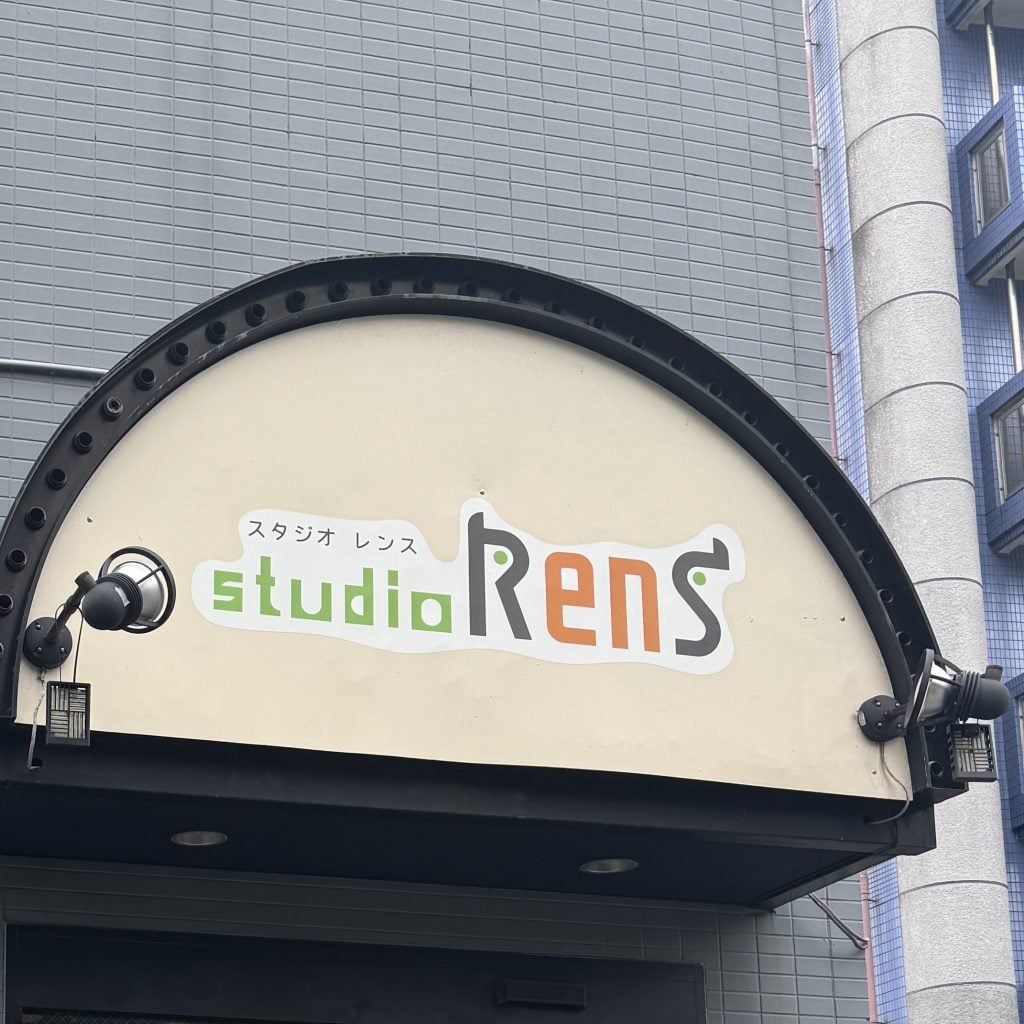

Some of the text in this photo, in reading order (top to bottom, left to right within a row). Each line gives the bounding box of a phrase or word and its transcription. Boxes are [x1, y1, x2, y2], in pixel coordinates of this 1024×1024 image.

[248, 519, 418, 556] スタジオ レンス
[212, 555, 453, 634] studio
